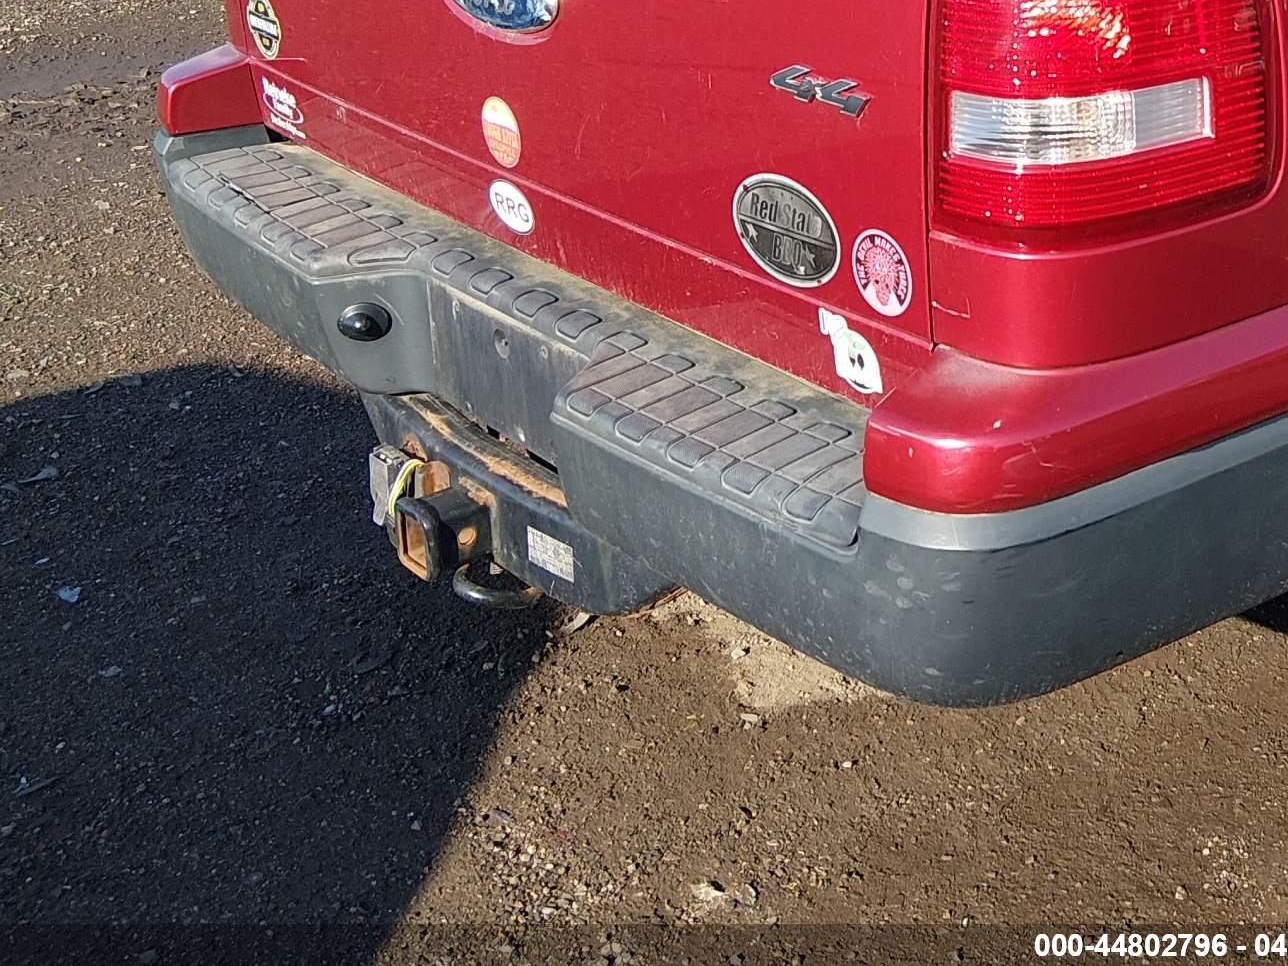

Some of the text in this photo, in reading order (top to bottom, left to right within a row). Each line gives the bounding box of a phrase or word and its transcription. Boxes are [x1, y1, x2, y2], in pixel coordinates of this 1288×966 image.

[494, 192, 530, 224] RRG
[750, 192, 779, 223] Red
[772, 233, 806, 274] BBQ
[857, 236, 874, 261] DEVIL
